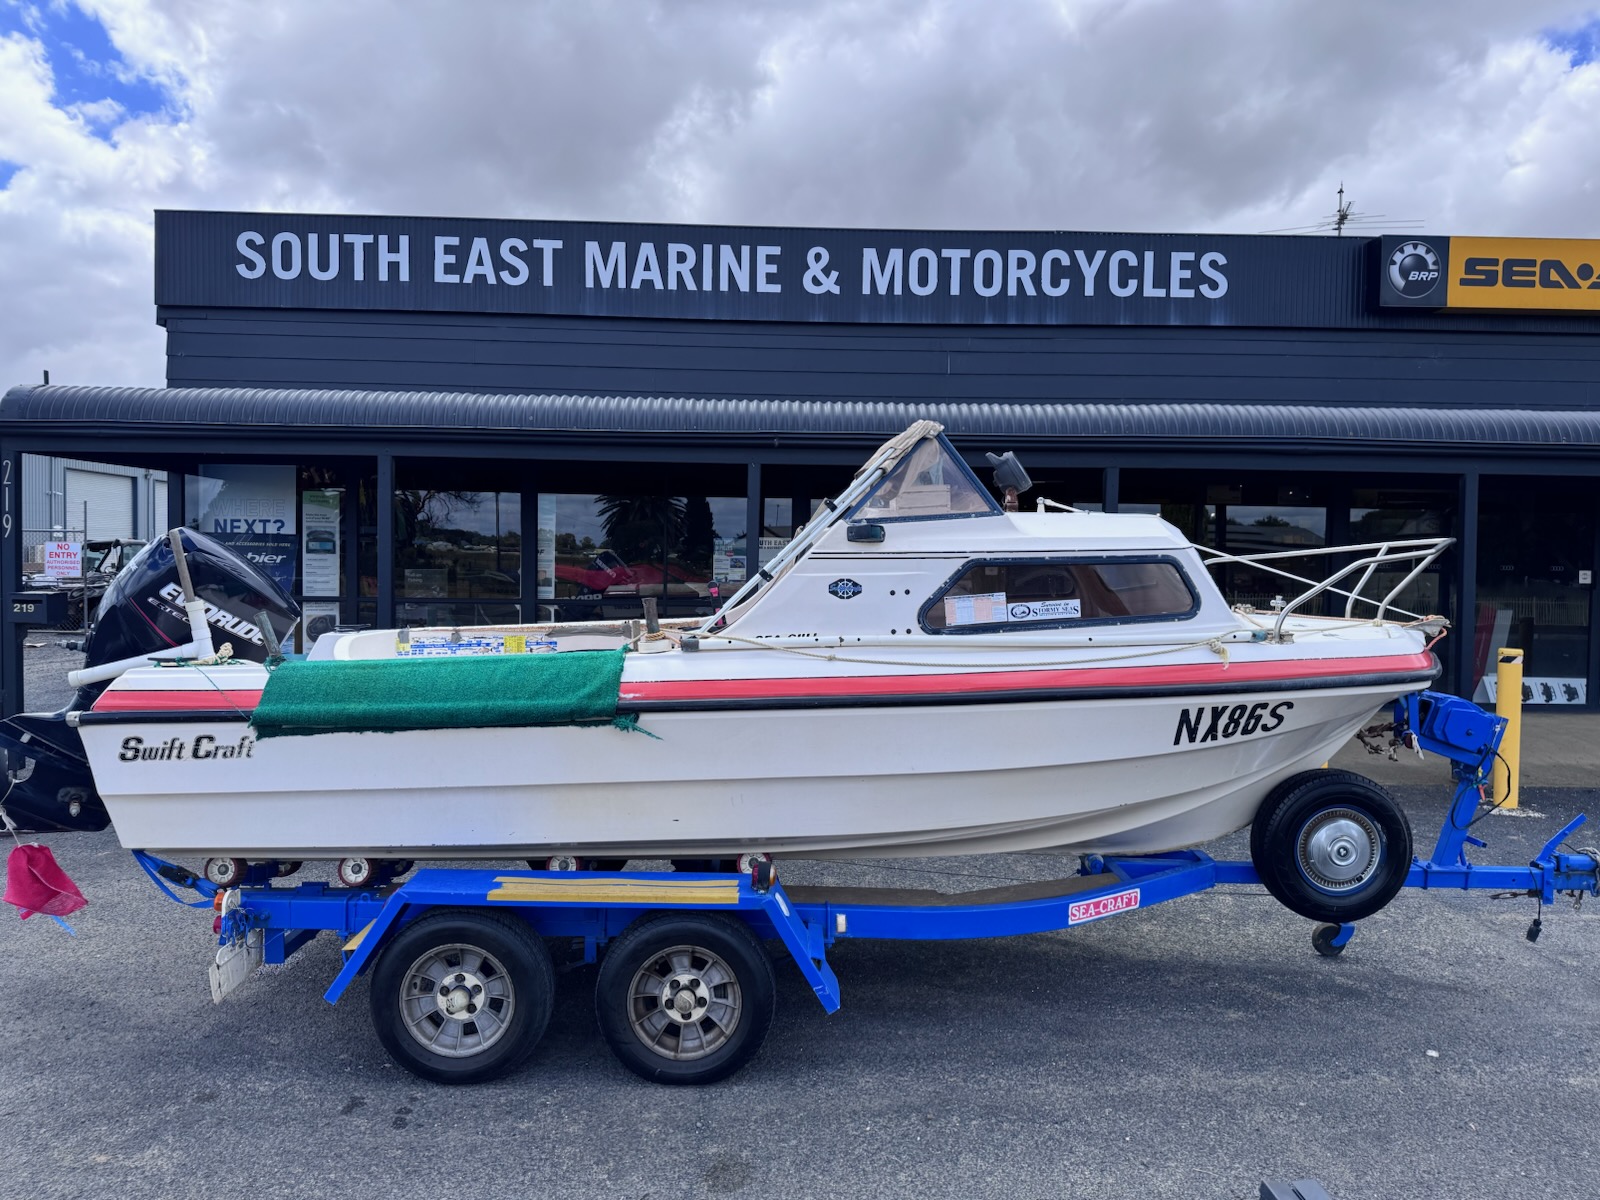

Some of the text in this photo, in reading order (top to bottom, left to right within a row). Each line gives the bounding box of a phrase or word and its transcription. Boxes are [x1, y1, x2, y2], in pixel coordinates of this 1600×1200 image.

[236, 230, 1229, 299] SOUTH EAST MARINE & MOTORCYCLES
[1408, 271, 1438, 281] BRP
[212, 499, 285, 517] WHERE
[214, 518, 285, 534] NEXT?
[49, 551, 78, 559] ENTRY
[245, 552, 287, 563] bier
[13, 603, 35, 612] 219
[1032, 607, 1059, 617] STORMY
[1061, 605, 1079, 615] SEAS
[119, 734, 255, 762] Swift Craft
[1071, 892, 1138, 920] SEA-CRAFT
